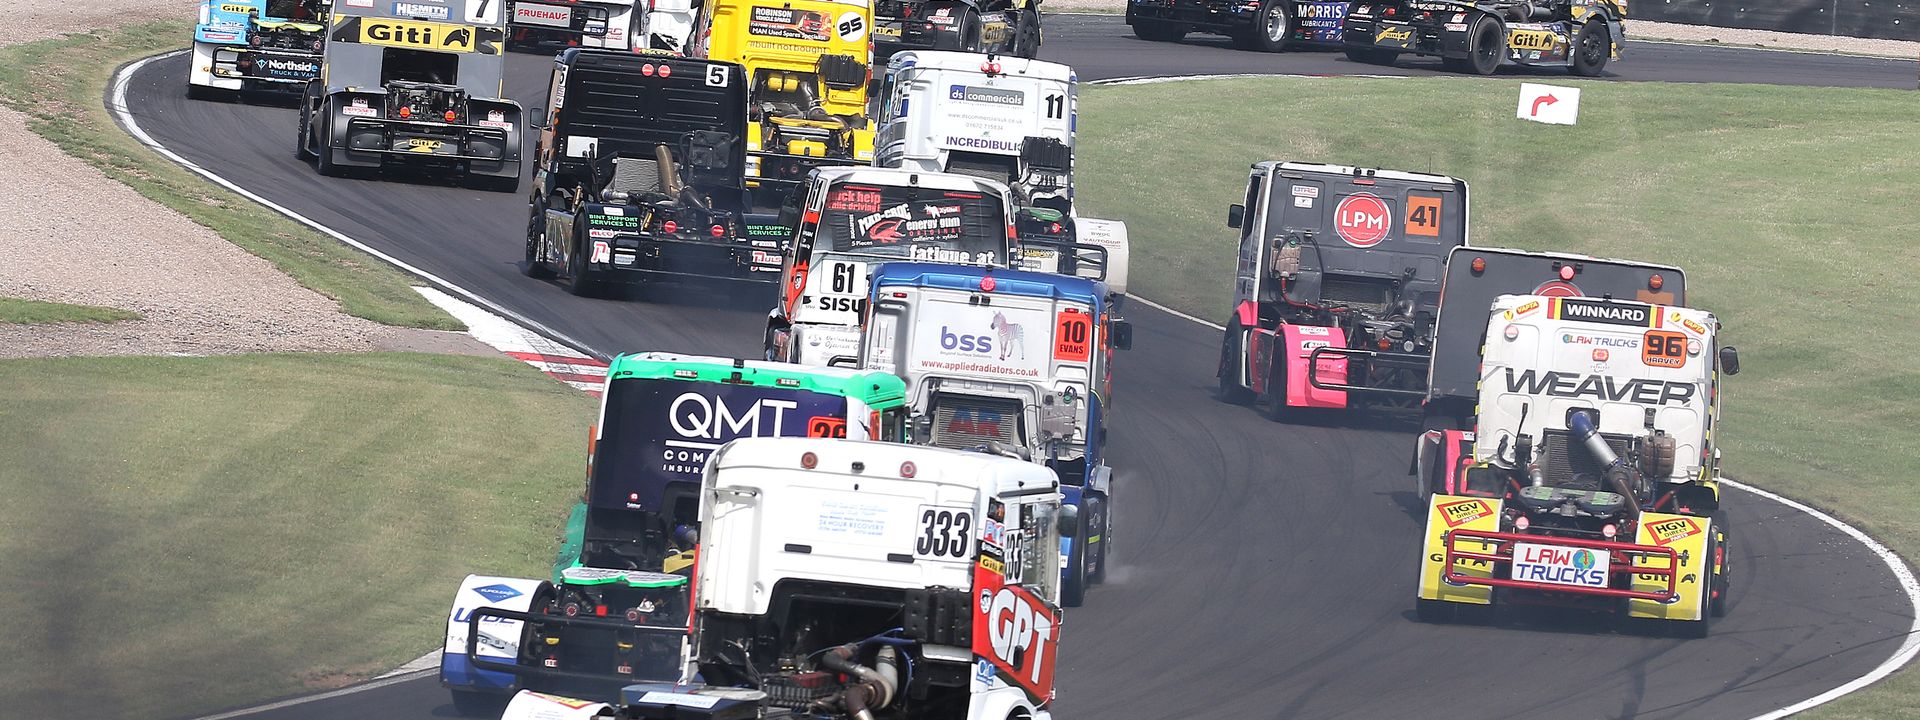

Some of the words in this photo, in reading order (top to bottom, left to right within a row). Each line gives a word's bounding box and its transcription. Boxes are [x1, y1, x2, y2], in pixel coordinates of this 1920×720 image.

[475, 0, 490, 18] 7
[517, 8, 568, 21] FRUEHAUF
[755, 8, 793, 18] ROBINSON
[1297, 4, 1342, 19] MORRIS
[838, 16, 863, 37] 95
[1301, 20, 1337, 28] LUBRICANTS
[367, 24, 432, 45] Giti
[1513, 34, 1539, 47] Giti
[268, 60, 319, 72] Northside
[270, 69, 292, 77] TRUCK
[709, 67, 725, 85] 5
[951, 89, 964, 99] ds
[967, 92, 1023, 105] commercials
[1045, 94, 1064, 119] 11
[857, 192, 881, 204] help
[857, 203, 912, 236] MAD-CROC
[906, 219, 938, 230] energy
[940, 217, 961, 228] gum
[1341, 210, 1384, 231] LPM
[1408, 205, 1438, 228] 41
[909, 228, 962, 236] ORIGINAL
[976, 251, 995, 267] at
[832, 262, 856, 294] 61
[1566, 303, 1645, 322] WINNARD
[940, 325, 992, 354] bss
[1061, 320, 1086, 343] 10
[1059, 344, 1084, 354] EVANS
[1569, 335, 1593, 345] LAW
[1594, 337, 1639, 348] TRUCKS
[1646, 335, 1683, 357] 96
[921, 360, 1039, 377] www.appliedradiators.co.uk
[1645, 357, 1681, 366] HARVEY
[1504, 367, 1696, 407] WEAVER
[669, 392, 798, 439] QMT
[947, 407, 1000, 438] AR
[1447, 503, 1478, 515] HGV
[916, 510, 971, 558] 333
[1655, 521, 1686, 534] HGV
[1525, 548, 1571, 566] LAW
[1516, 563, 1605, 585] TRUCKS
[988, 588, 1052, 685] GPT
